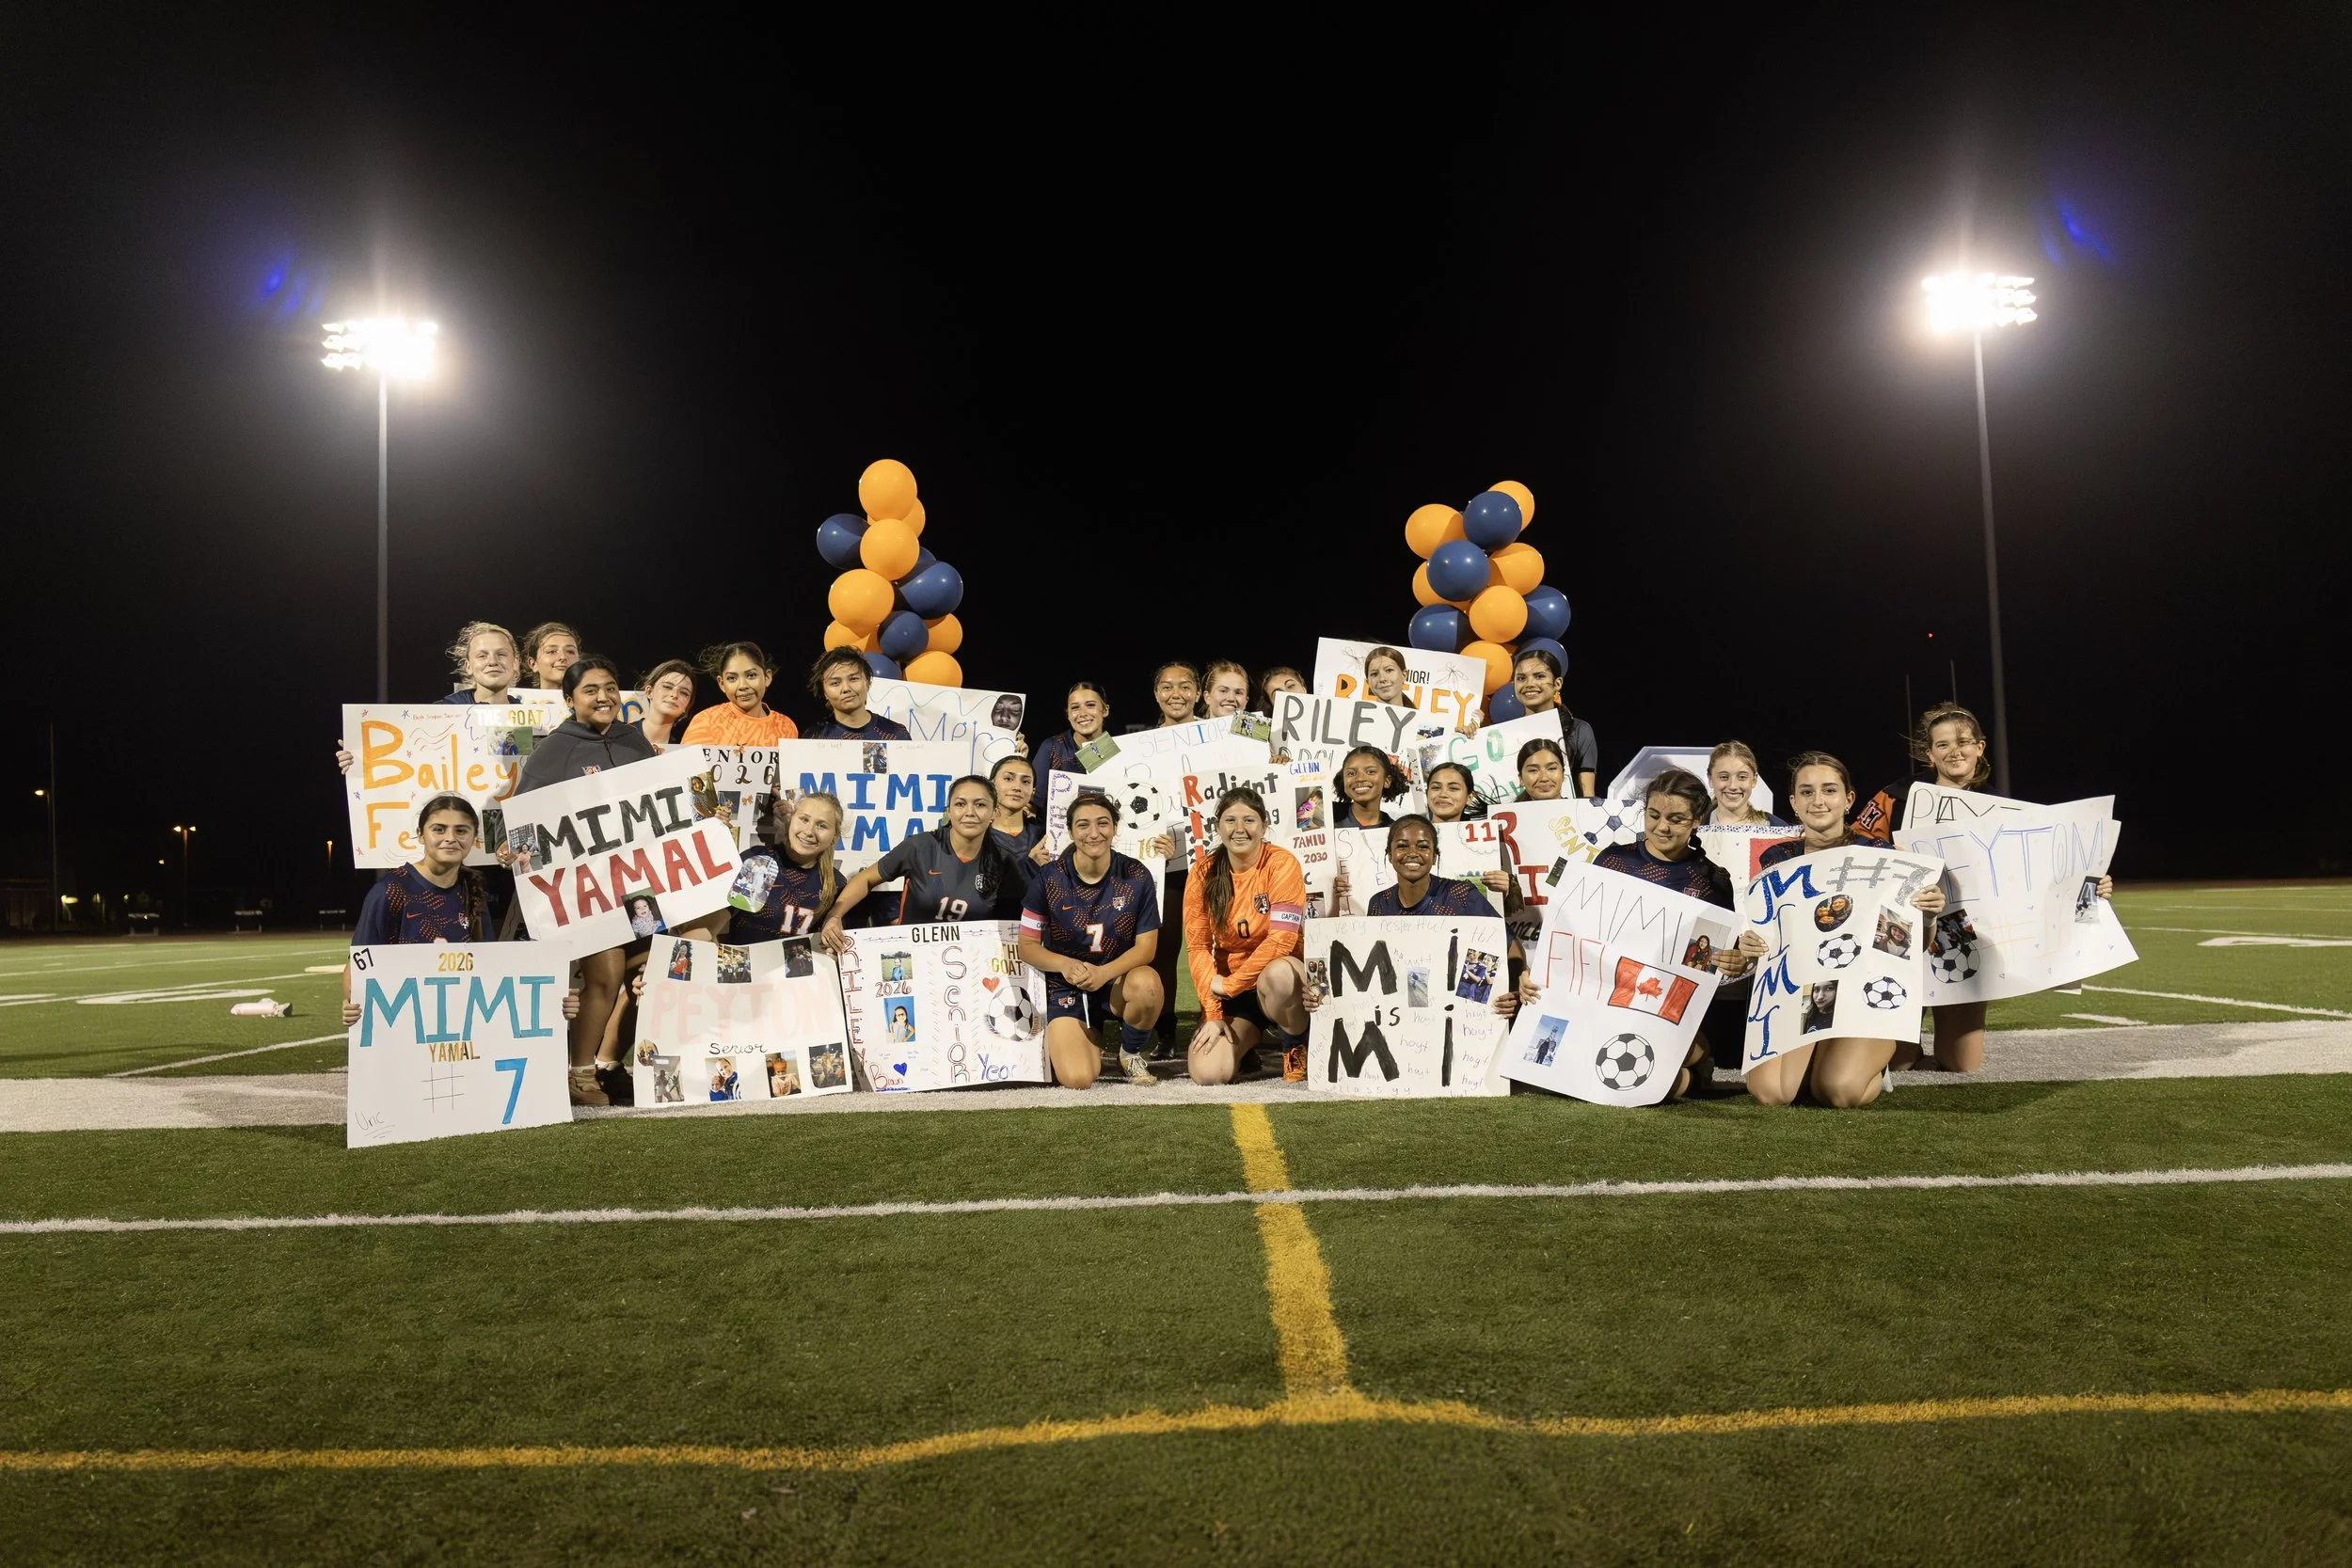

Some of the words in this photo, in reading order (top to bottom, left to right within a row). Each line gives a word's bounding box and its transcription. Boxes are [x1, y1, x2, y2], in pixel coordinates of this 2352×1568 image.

[508, 709, 544, 726] GOAT
[1281, 695, 1417, 753] RILEY
[361, 721, 517, 801] Bailey
[703, 749, 780, 764] ENIOR
[711, 764, 774, 784] 026
[1289, 762, 1320, 775] GLENN
[536, 785, 693, 865] MIMI
[1465, 821, 1497, 843] 11
[1303, 851, 1328, 864] 2030
[529, 830, 734, 927] YAMAL
[779, 904, 815, 935] 17
[935, 896, 968, 922] 19
[1554, 876, 1682, 965] MIMI
[912, 925, 961, 943] GLENN
[1084, 923, 1105, 953] 7
[353, 948, 373, 971] 67
[438, 952, 473, 972] 2026
[991, 958, 1023, 976] GOAT
[875, 981, 912, 997] 2026
[360, 975, 555, 1047] MIMI
[650, 974, 832, 1046] PEYTON
[1375, 1005, 1401, 1026] is
[429, 1041, 480, 1063] YAMAL
[708, 1042, 768, 1055] Senior
[495, 1057, 528, 1125] 7
